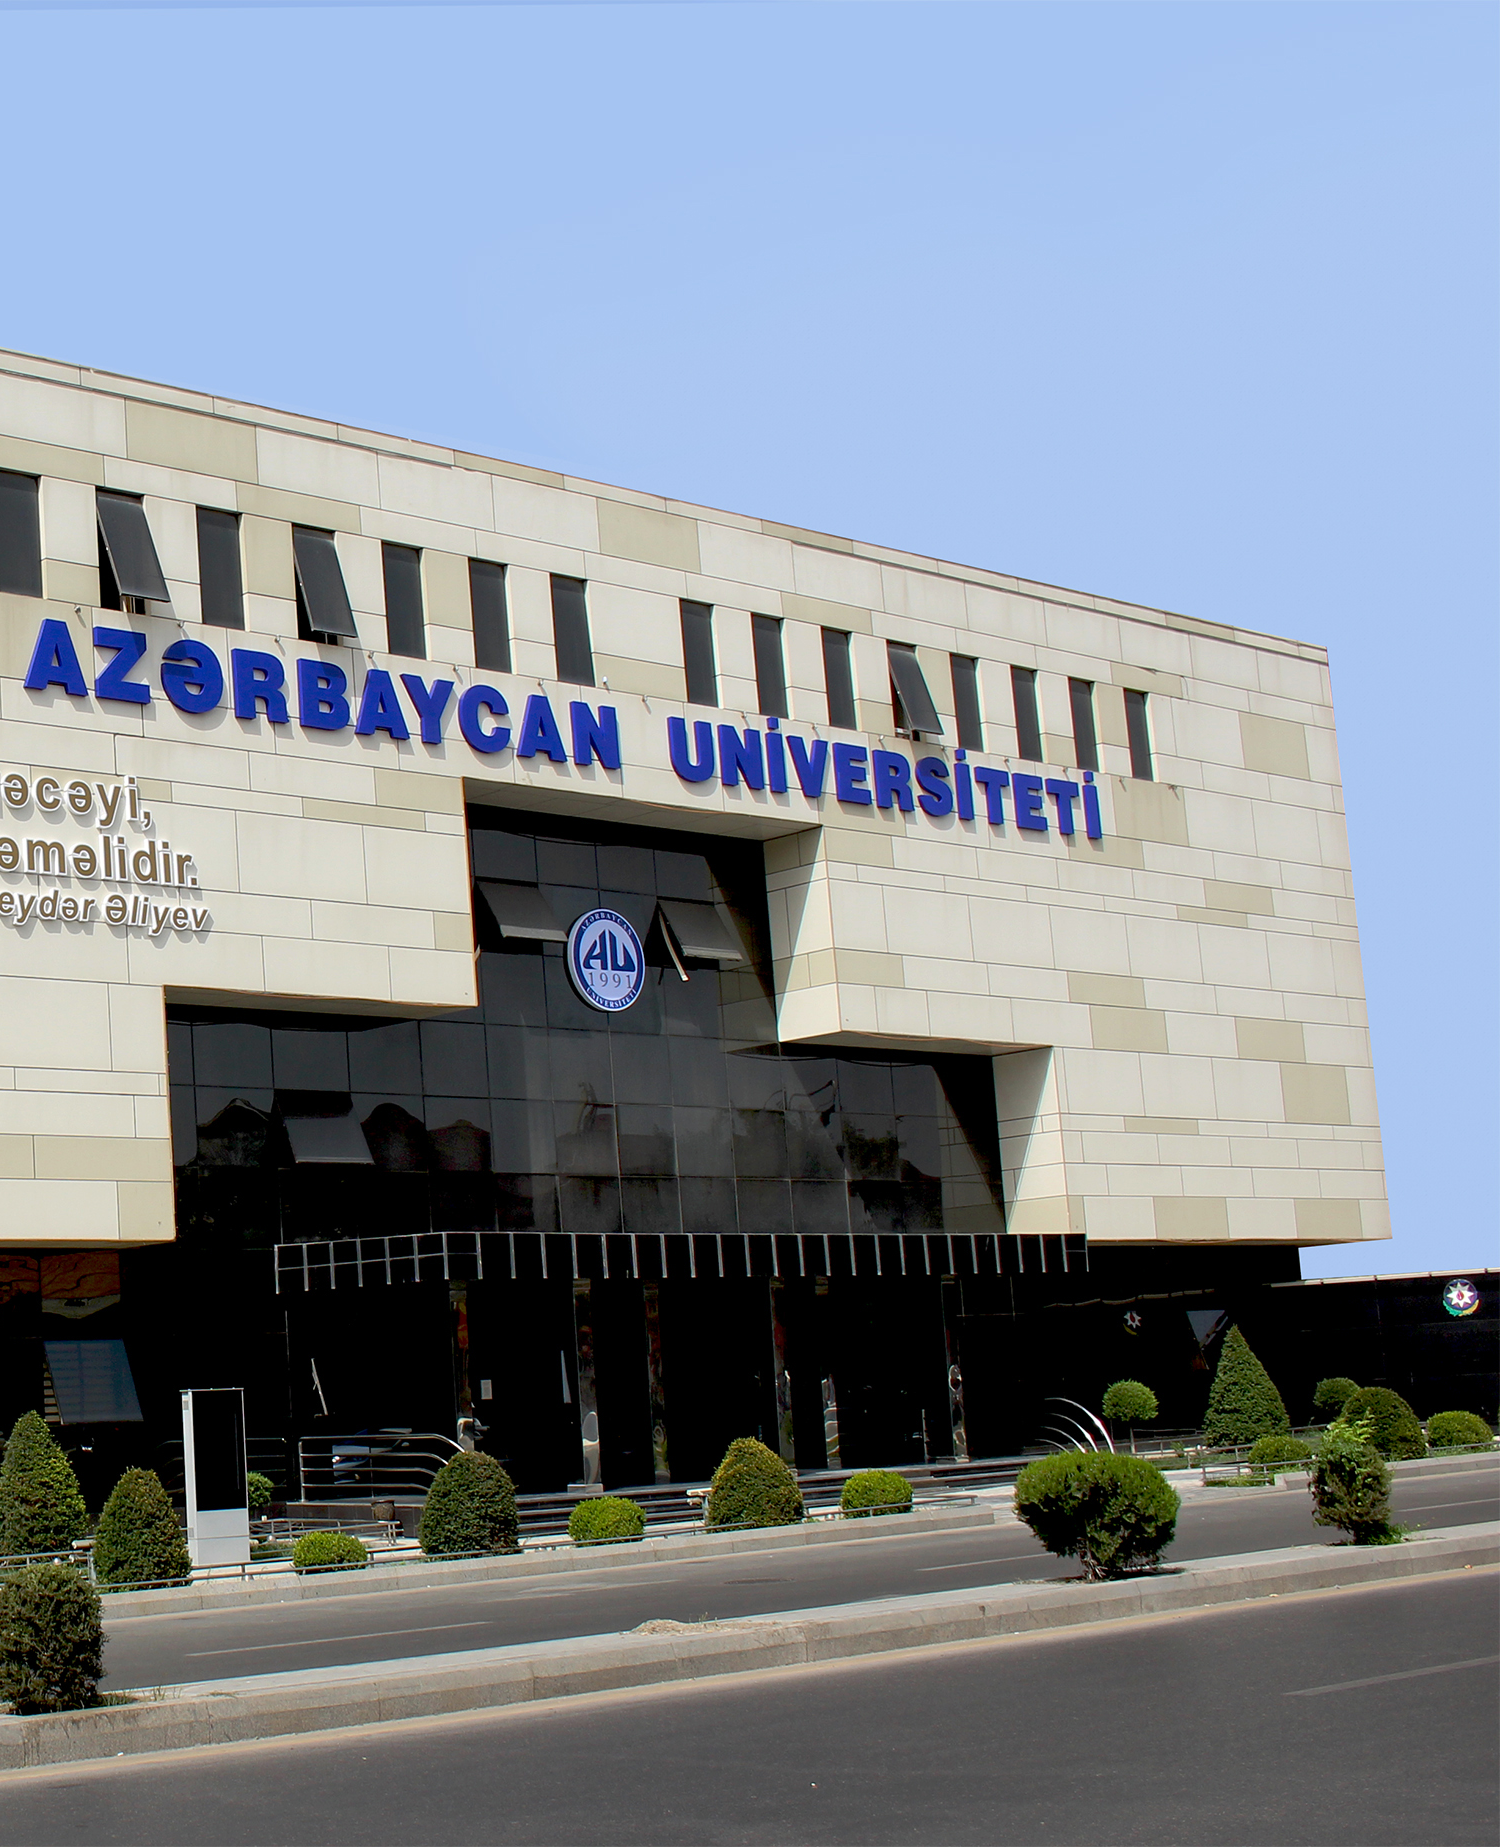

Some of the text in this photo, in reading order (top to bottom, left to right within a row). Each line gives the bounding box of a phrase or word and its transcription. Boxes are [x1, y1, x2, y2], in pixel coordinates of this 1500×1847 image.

[24, 618, 1102, 839] AZƏRBAYCAN UNİVERSİTETİ
[105, 892, 210, 937] Əliyev
[588, 972, 633, 989] 1991
